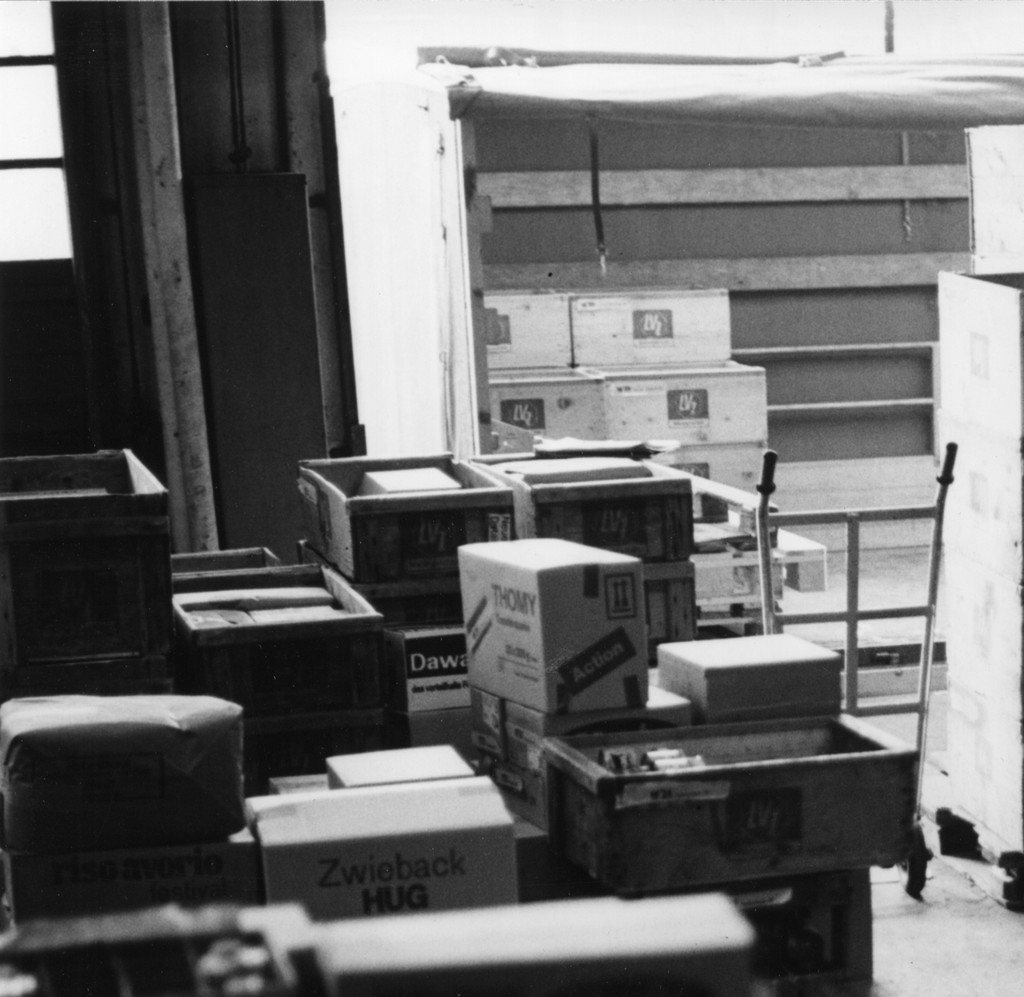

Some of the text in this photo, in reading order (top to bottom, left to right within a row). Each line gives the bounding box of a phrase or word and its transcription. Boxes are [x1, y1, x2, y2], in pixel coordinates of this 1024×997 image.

[491, 583, 537, 617] THOMY
[410, 652, 468, 672] Dawa
[571, 641, 626, 683] Action
[122, 847, 223, 880] avorio
[318, 847, 466, 888] Zwieback
[362, 883, 429, 914] HUG
